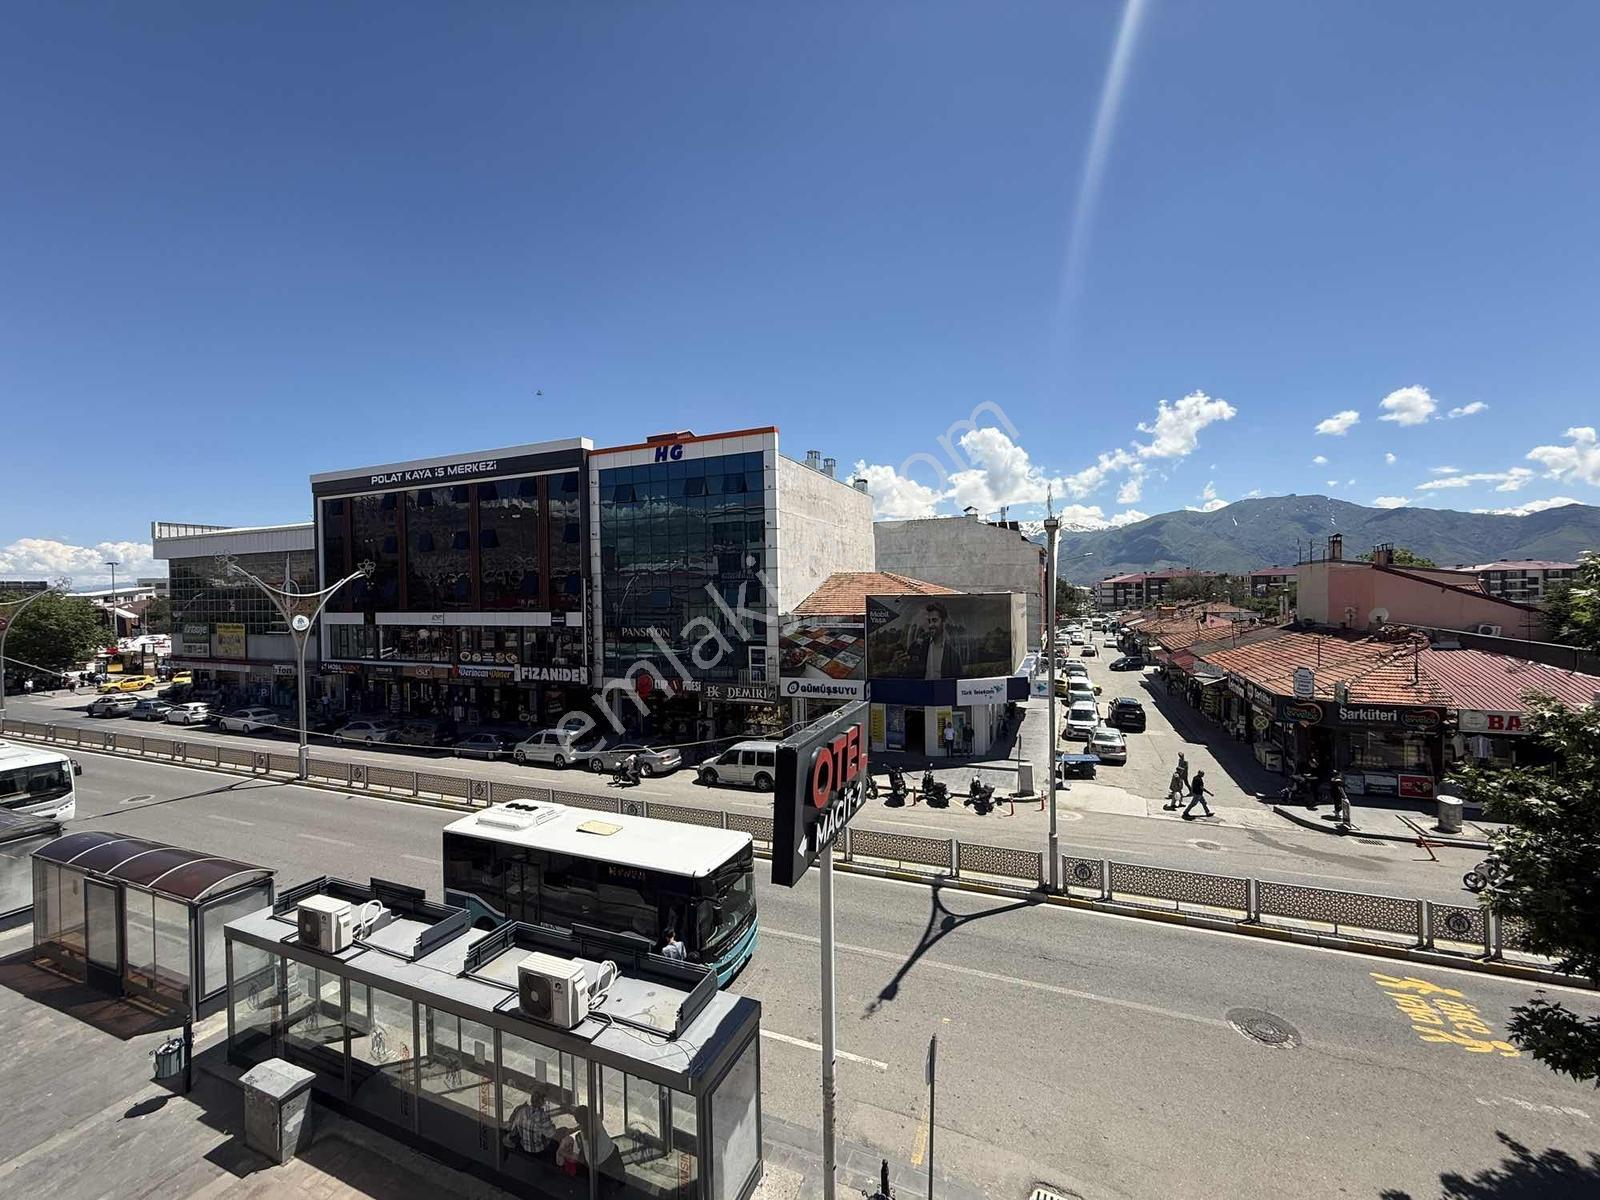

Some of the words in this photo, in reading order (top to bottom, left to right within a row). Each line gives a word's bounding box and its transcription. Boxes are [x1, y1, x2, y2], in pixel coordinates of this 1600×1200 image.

[655, 444, 683, 463] HG
[371, 473, 403, 485] POLAT
[405, 469, 432, 481] KAYA
[1487, 715, 1522, 731] BA
[812, 722, 868, 809] OTEL
